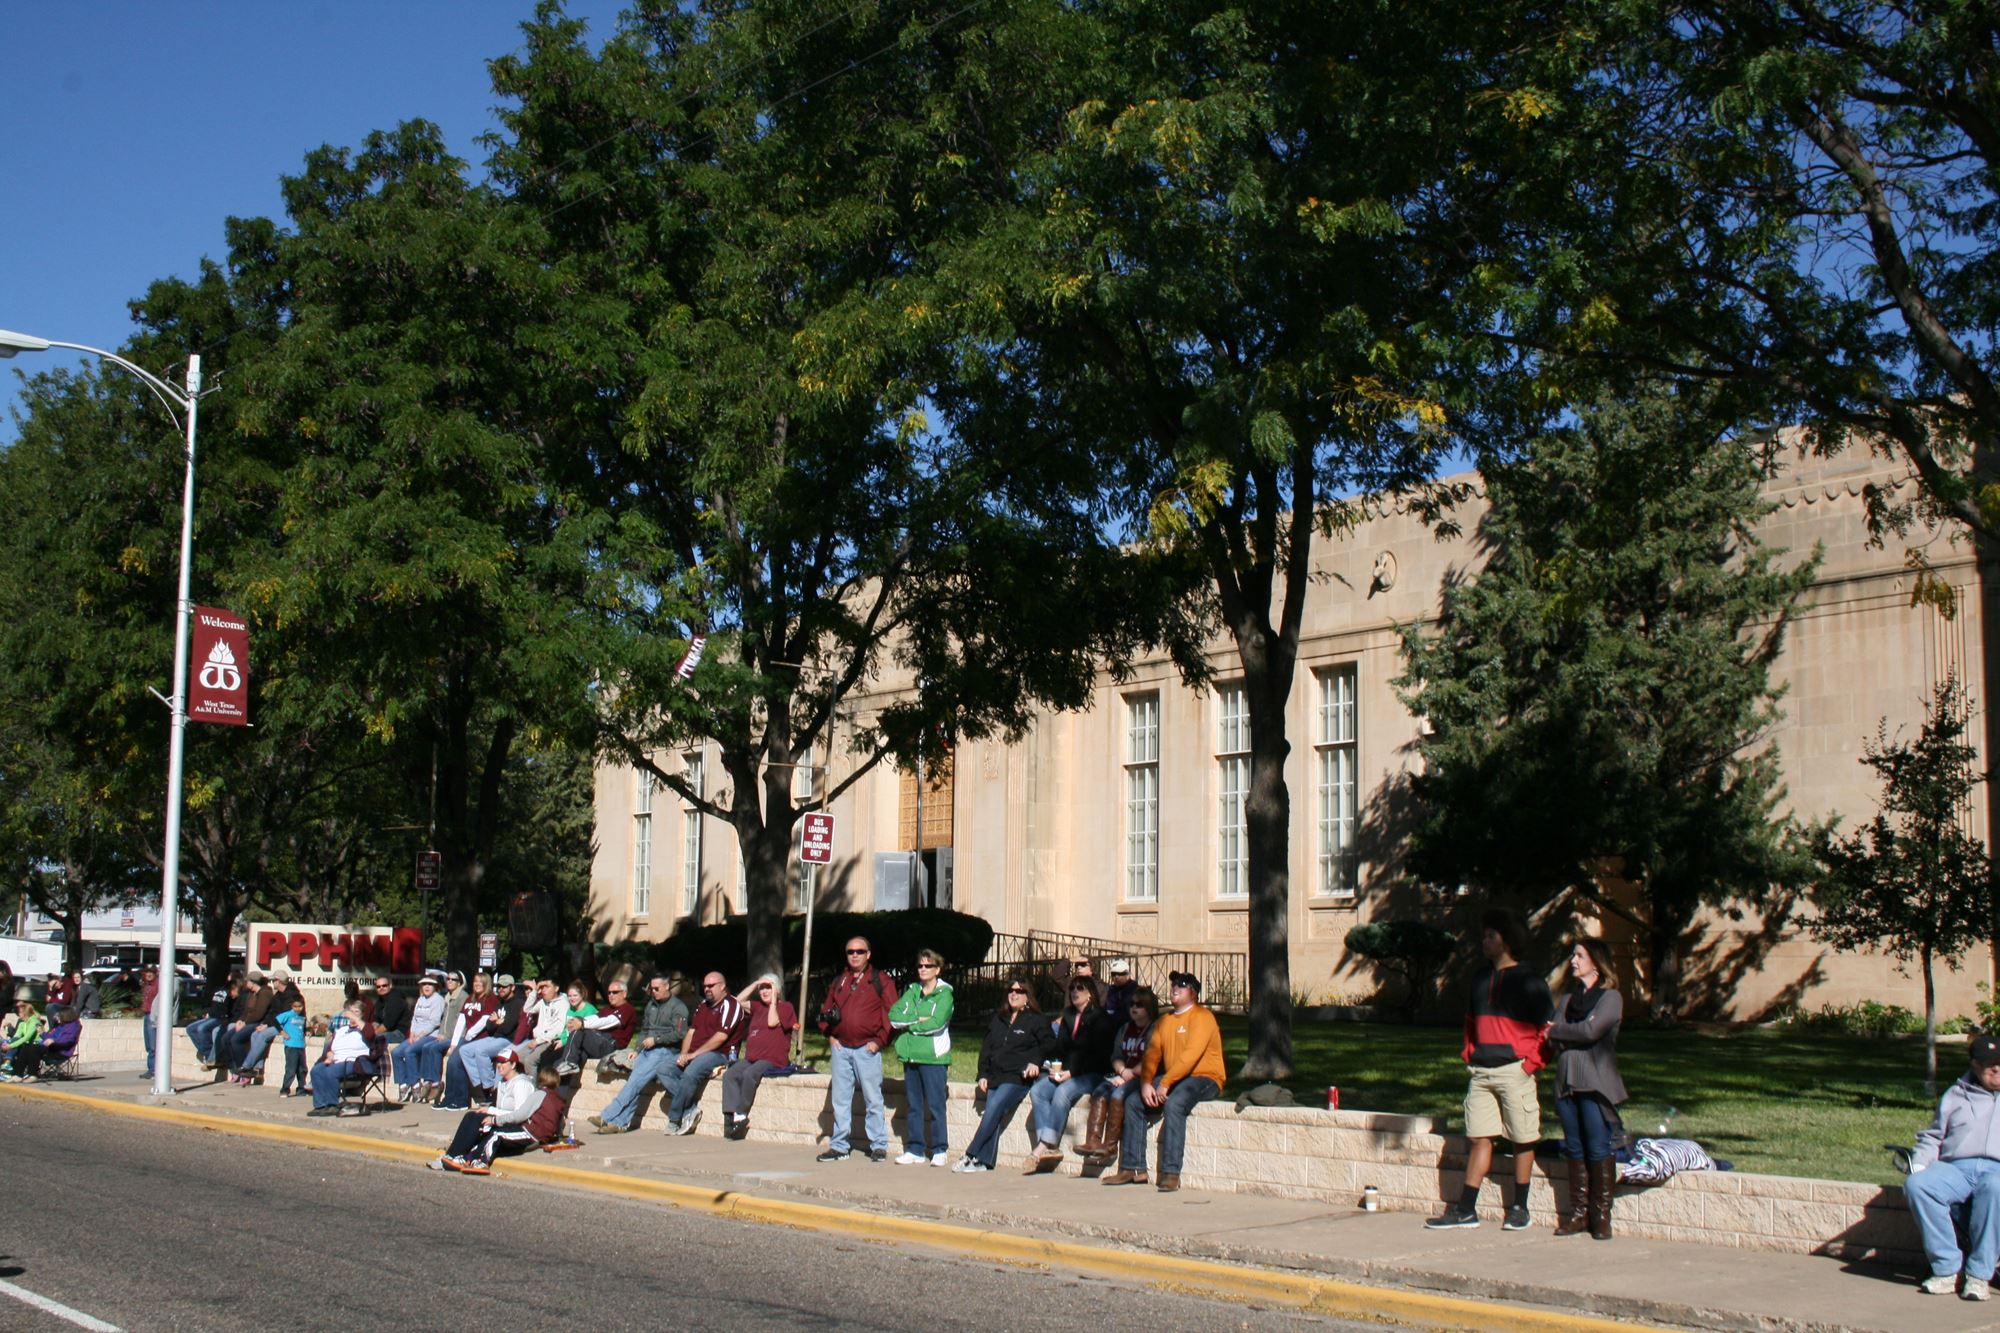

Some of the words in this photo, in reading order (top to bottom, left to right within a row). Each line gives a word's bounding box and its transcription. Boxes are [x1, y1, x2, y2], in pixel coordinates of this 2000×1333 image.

[201, 615, 245, 631] Welcome
[204, 700, 218, 708] West
[219, 701, 235, 709] Texas
[195, 706, 212, 714] A&M
[213, 706, 242, 716] University
[814, 818, 824, 826] BUS
[808, 825, 828, 834] LOADING
[804, 841, 830, 850] UNLOADING
[810, 849, 822, 857] ONLY
[256, 931, 392, 972] PPHM
